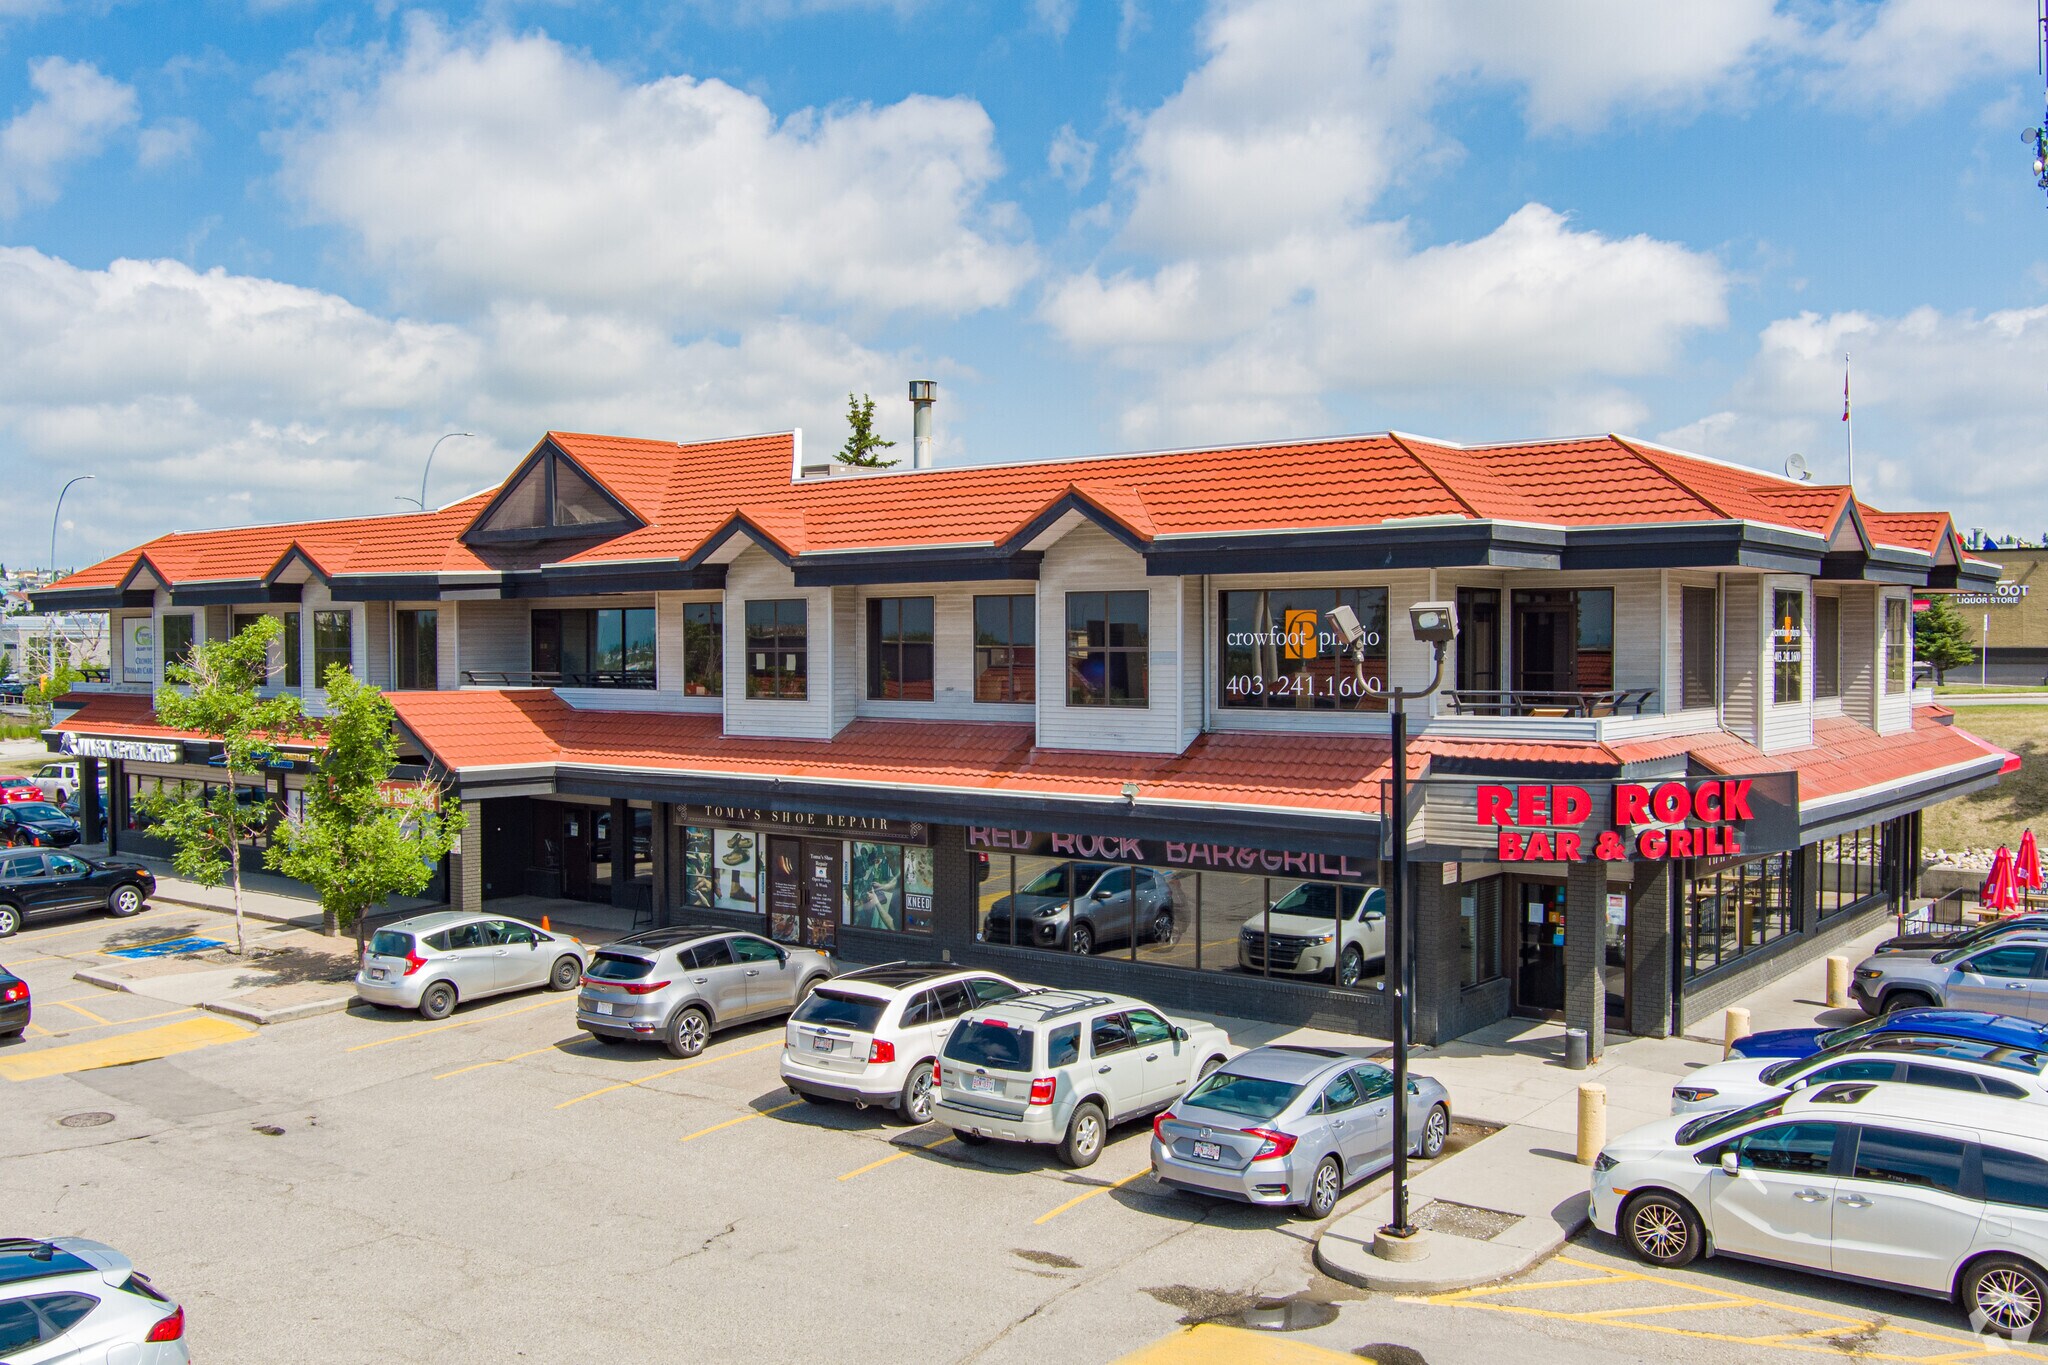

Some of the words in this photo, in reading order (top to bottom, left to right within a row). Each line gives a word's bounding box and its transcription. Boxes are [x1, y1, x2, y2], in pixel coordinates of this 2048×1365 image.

[1990, 596, 2019, 604] STORE
[1226, 625, 1307, 646] crowfoot
[1476, 785, 1593, 826] RED
[1613, 779, 1755, 826] ROCK
[705, 805, 761, 820] TOMA'S
[771, 810, 815, 825] SHOE
[826, 814, 888, 830] REPAIR
[969, 825, 1033, 850] RED
[1052, 832, 1145, 861] ROCK
[1498, 830, 1582, 862] BAR
[1593, 830, 1627, 861] &
[1637, 826, 1742, 860] GRILL
[907, 896, 931, 909] KNEED
